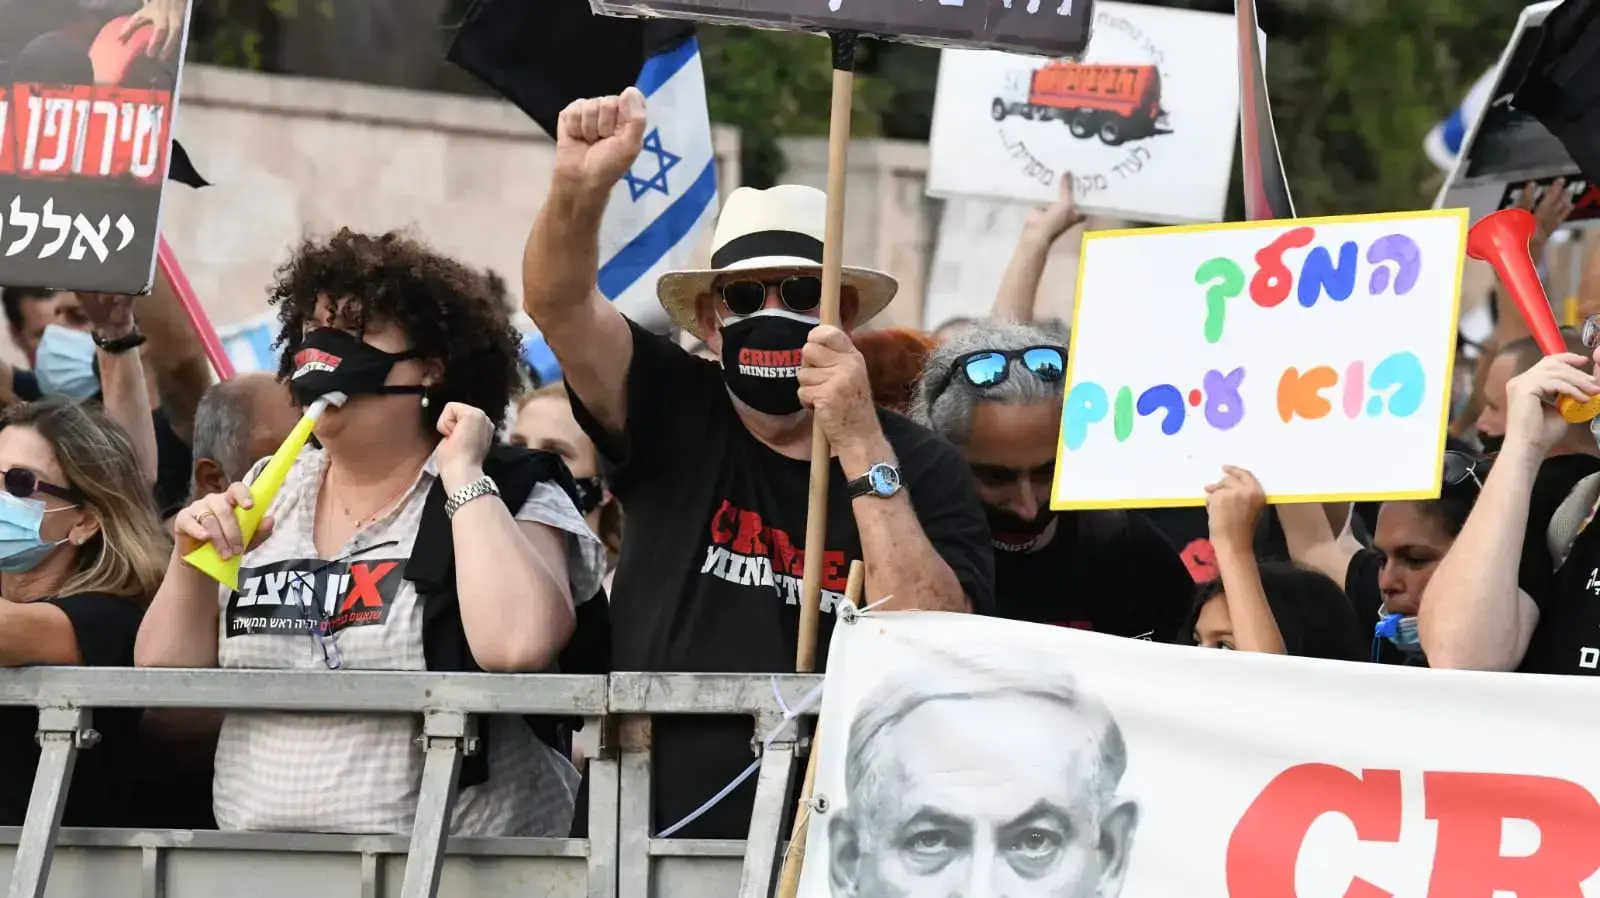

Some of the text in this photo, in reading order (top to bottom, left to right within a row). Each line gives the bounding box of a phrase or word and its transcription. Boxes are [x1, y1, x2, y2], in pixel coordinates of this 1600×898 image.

[1075, 173, 1108, 198] מקו
[0, 194, 136, 264] יאלל
[1195, 226, 1422, 344] המלך
[739, 347, 803, 367] CRIME
[1062, 351, 1426, 451] הוא עירום
[700, 545, 846, 614] MINISTR
[233, 617, 267, 631] ממשלה
[270, 617, 293, 629] ראש
